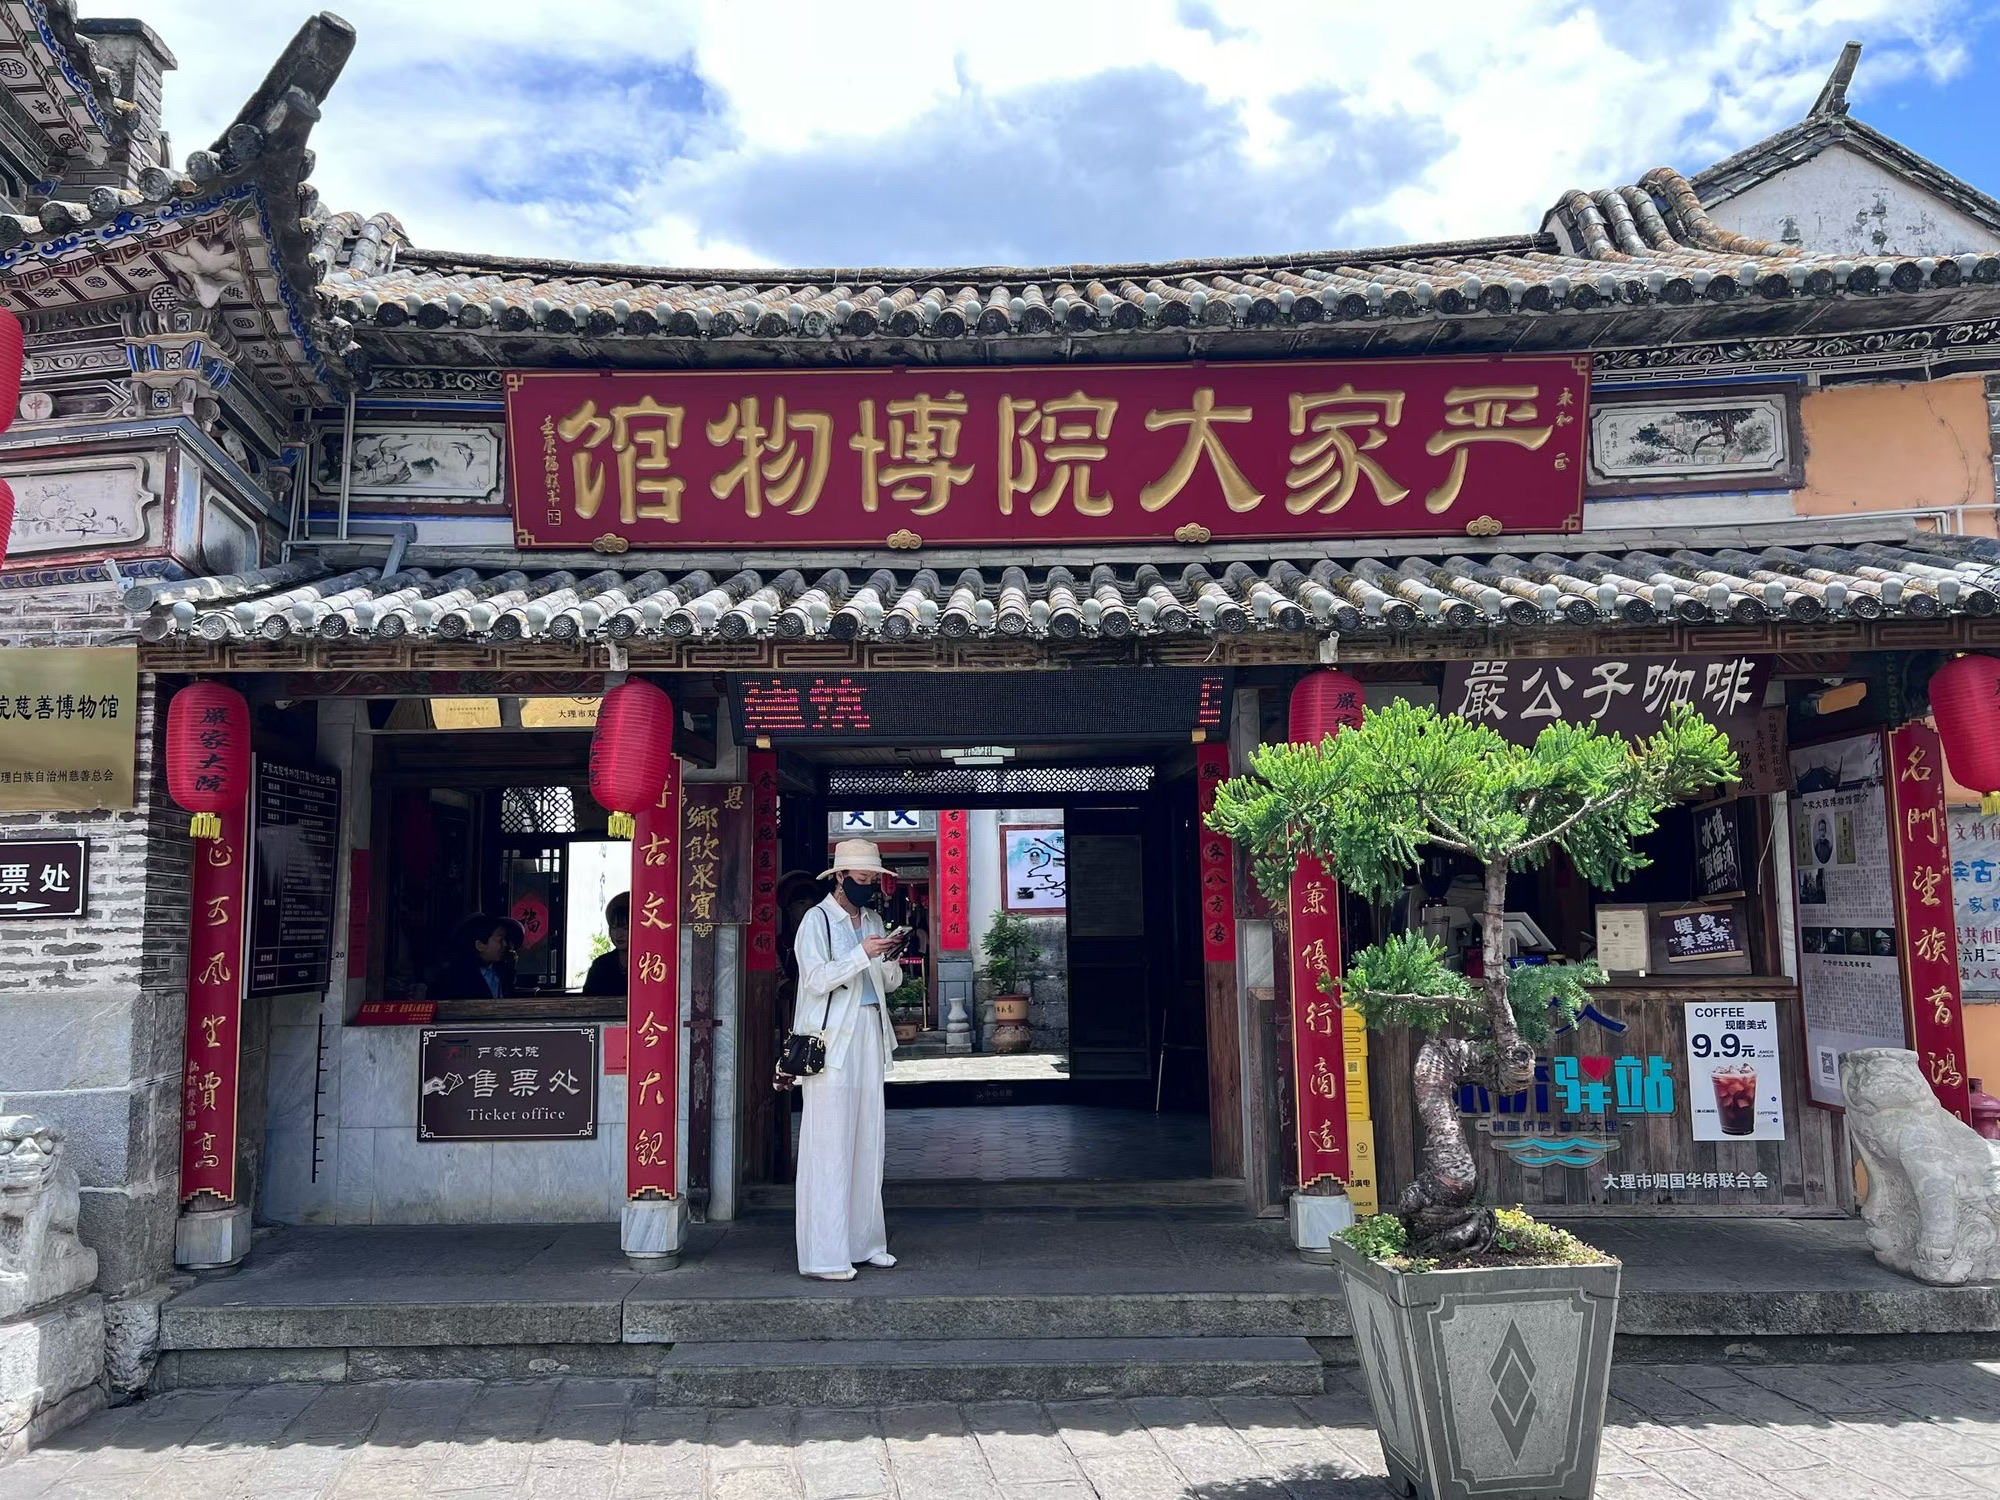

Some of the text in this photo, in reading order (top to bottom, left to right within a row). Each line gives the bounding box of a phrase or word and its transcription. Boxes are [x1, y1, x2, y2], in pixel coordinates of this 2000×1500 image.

[556, 384, 1553, 525] 严家大院博物馆
[1695, 1007, 1745, 1018] COFFEE
[1725, 1020, 1768, 1030] 现磨美式
[477, 1046, 540, 1059] 严家大院
[467, 1068, 581, 1098] 售票处
[467, 1107, 566, 1121] Ticket office
[1603, 1171, 1769, 1190] 大理市归国华侨联合会
